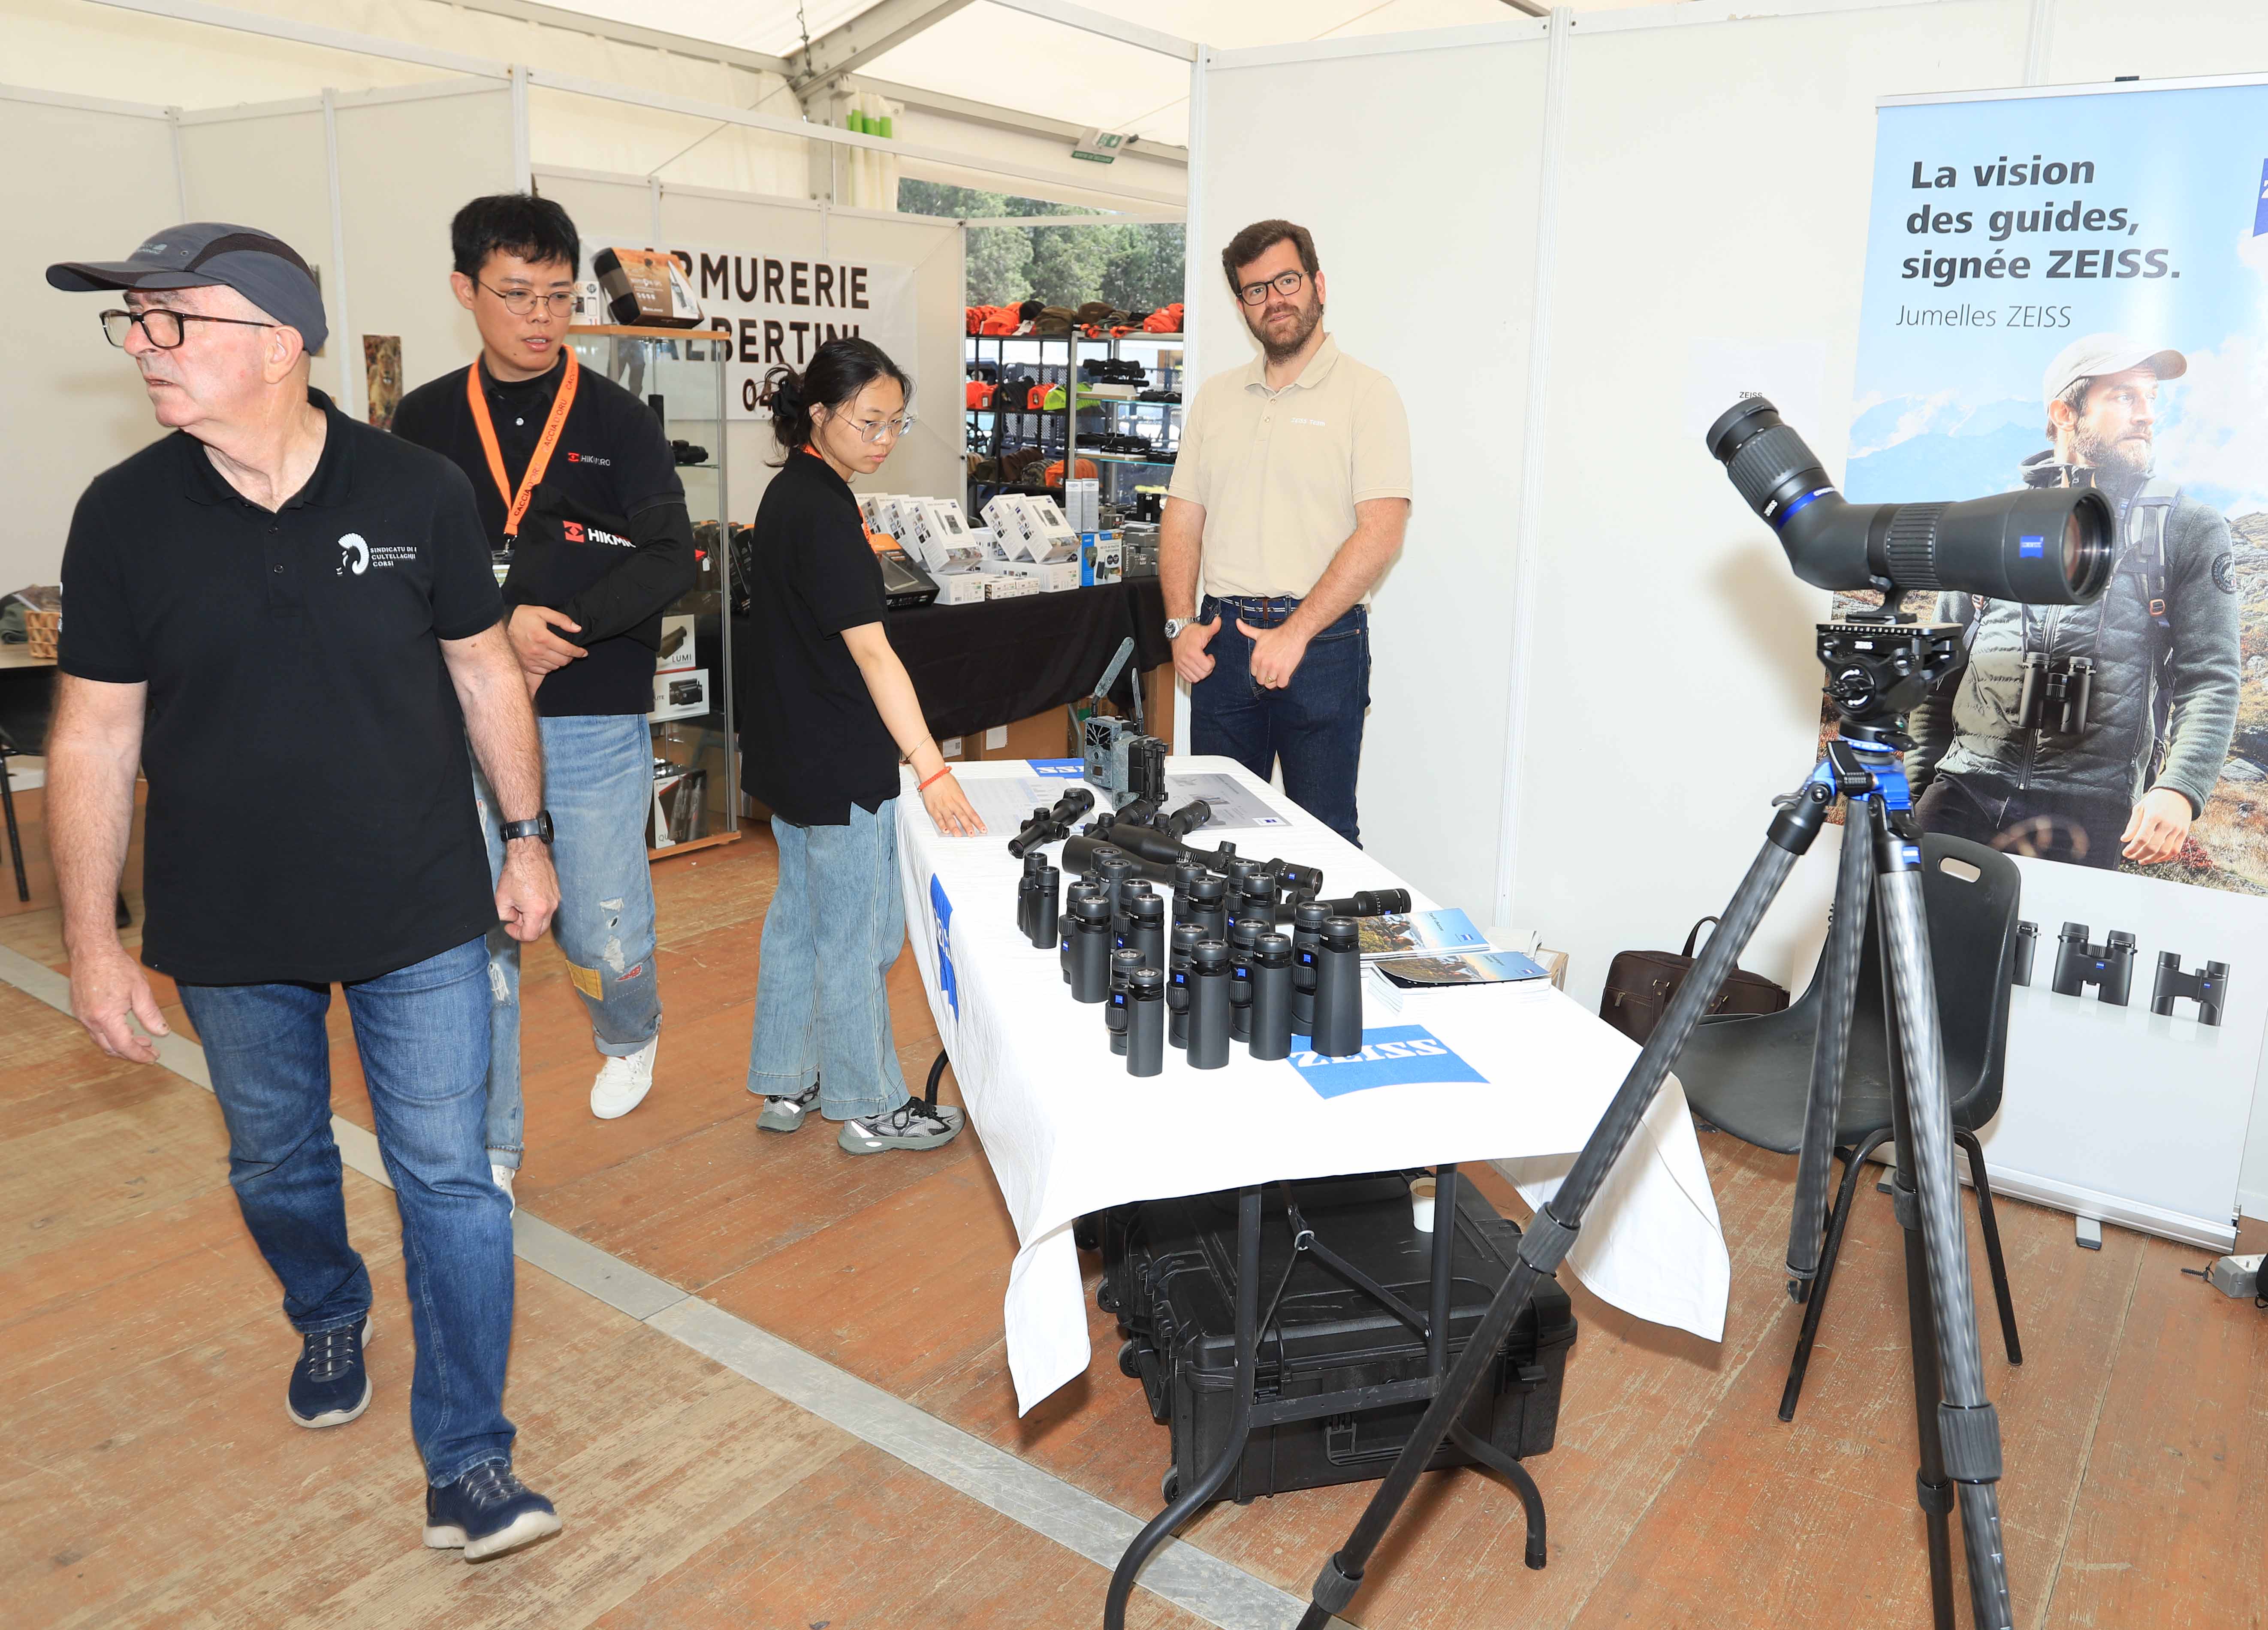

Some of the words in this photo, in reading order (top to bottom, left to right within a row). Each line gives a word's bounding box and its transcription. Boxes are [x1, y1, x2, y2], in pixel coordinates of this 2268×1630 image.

[1911, 161, 1957, 189] La
[1973, 154, 2095, 187] vision
[1906, 204, 1973, 234] des
[1988, 200, 2139, 241] guides,
[645, 247, 869, 310] MURERIE
[1901, 248, 2031, 287] signée
[2045, 248, 2181, 279] ZEISS.
[1896, 304, 1997, 327] Jumelles
[2006, 305, 2072, 328] ZEISS
[541, 422, 558, 453] CACCIA
[514, 488, 531, 516] CACCIA
[1764, 499, 1778, 517] ZEISS
[672, 654, 692, 663] LUMI
